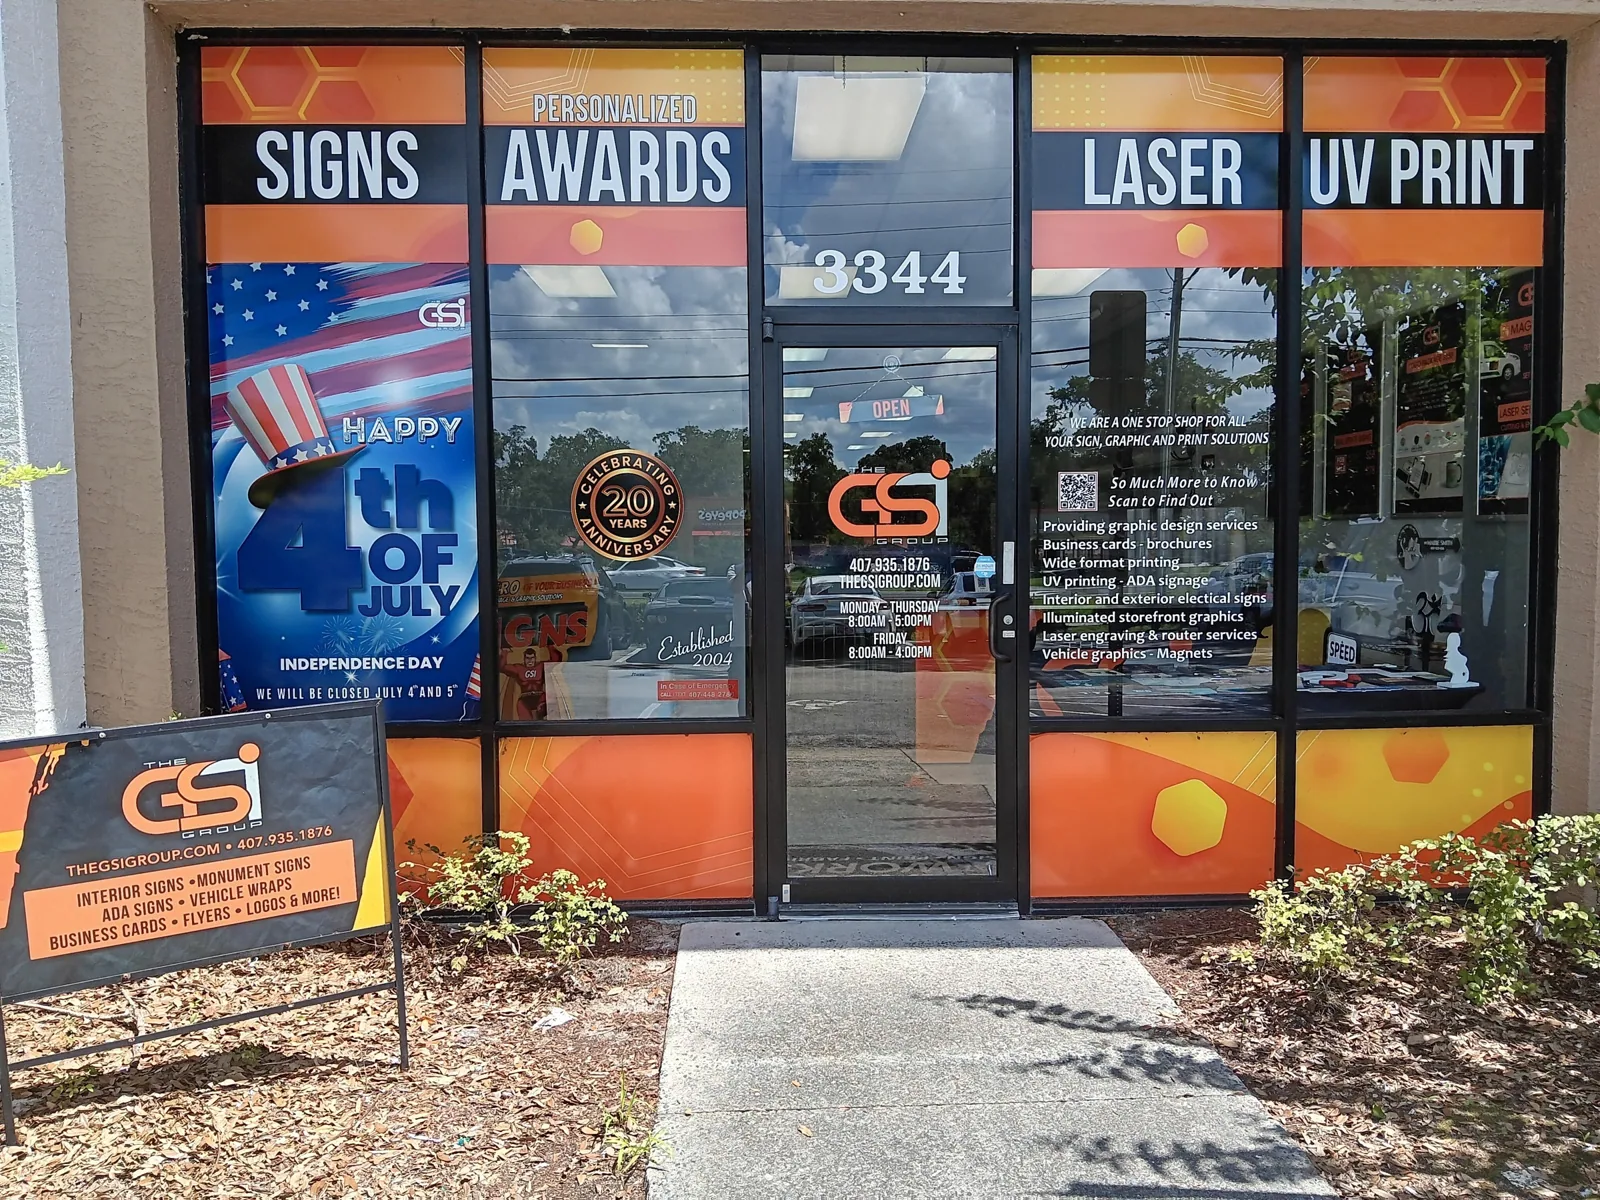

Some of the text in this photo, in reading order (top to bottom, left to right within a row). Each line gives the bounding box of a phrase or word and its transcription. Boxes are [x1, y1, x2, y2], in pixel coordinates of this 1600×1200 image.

[533, 94, 697, 123] PERSONALIZED
[256, 131, 419, 199] SIGNS
[501, 129, 731, 202] AWARDS
[1084, 138, 1242, 205] LASER
[1309, 138, 1534, 205] UV PRINT
[813, 250, 967, 294] 3344
[872, 399, 910, 418] OPEN
[343, 417, 462, 444] HAPPY
[1070, 416, 1246, 429] WE ARE A ONE STOP SHOP FOR ALL
[1045, 433, 1269, 449] YOUR SIGN, GRAPHIC AND PRINT SOLUTIONS
[581, 456, 674, 496] CELEBRATING
[1111, 476, 1257, 489] So Much More to Know
[602, 485, 654, 517] 20
[1108, 495, 1213, 507] Scan to Find Out
[610, 519, 647, 528] YEARS
[1043, 520, 1258, 534] Providing graphic design services
[580, 515, 675, 556] ANNIVERSARY
[1043, 539, 1098, 550] Business
[1102, 539, 1136, 549] cards
[1147, 538, 1212, 549] brochures
[368, 533, 458, 584] OF
[850, 558, 930, 572] 407.935.1876
[1043, 557, 1179, 570] Wide format printing
[840, 574, 940, 589] THEGSIGROUP.COM
[1043, 576, 1061, 587] UV
[1065, 575, 1116, 589] printing
[1126, 575, 1155, 586] ADA
[1158, 575, 1208, 588] signage
[358, 585, 460, 617] JULY
[1043, 592, 1267, 606] Interior and exterior electical signs
[840, 602, 881, 614] MONDAY
[890, 601, 940, 613] THURSDAY
[848, 615, 885, 628] 8:00AM
[895, 614, 931, 627] 5:00PM
[1043, 611, 1243, 624] Illuminated storefront graphics
[658, 620, 734, 660] Established
[874, 632, 907, 644] FRIDAY
[1043, 629, 1257, 644] Laser engraving & router services
[692, 652, 732, 666] 2004
[849, 647, 886, 659] 8:00AM
[895, 646, 932, 658] 4:00PM
[1042, 648, 1088, 660] Vehicle
[1091, 648, 1146, 662] graphics
[1157, 648, 1212, 661] Magnets
[1329, 640, 1355, 663] SPEED
[280, 656, 444, 670] INDEPENDENCE DAY
[256, 688, 272, 700] WE
[277, 688, 304, 700] WILL
[310, 687, 322, 699] BE
[328, 686, 370, 699] CLOSED
[376, 686, 402, 698] JULY
[420, 686, 442, 698] AND
[448, 684, 458, 697] 5th
[144, 758, 187, 768] THE
[182, 820, 262, 839] GROUP
[66, 826, 332, 877] THEGSIGROUP.COM 407.935.1876
[77, 884, 140, 907] INTERIOR
[145, 878, 184, 898] SIGNS
[274, 856, 311, 874] SIGNS
[102, 878, 292, 922] ADA SIGNS VEHICLE WRAPS
[50, 887, 340, 951] BUSINESS CARDS FLYERS LOGOS & MORE!
